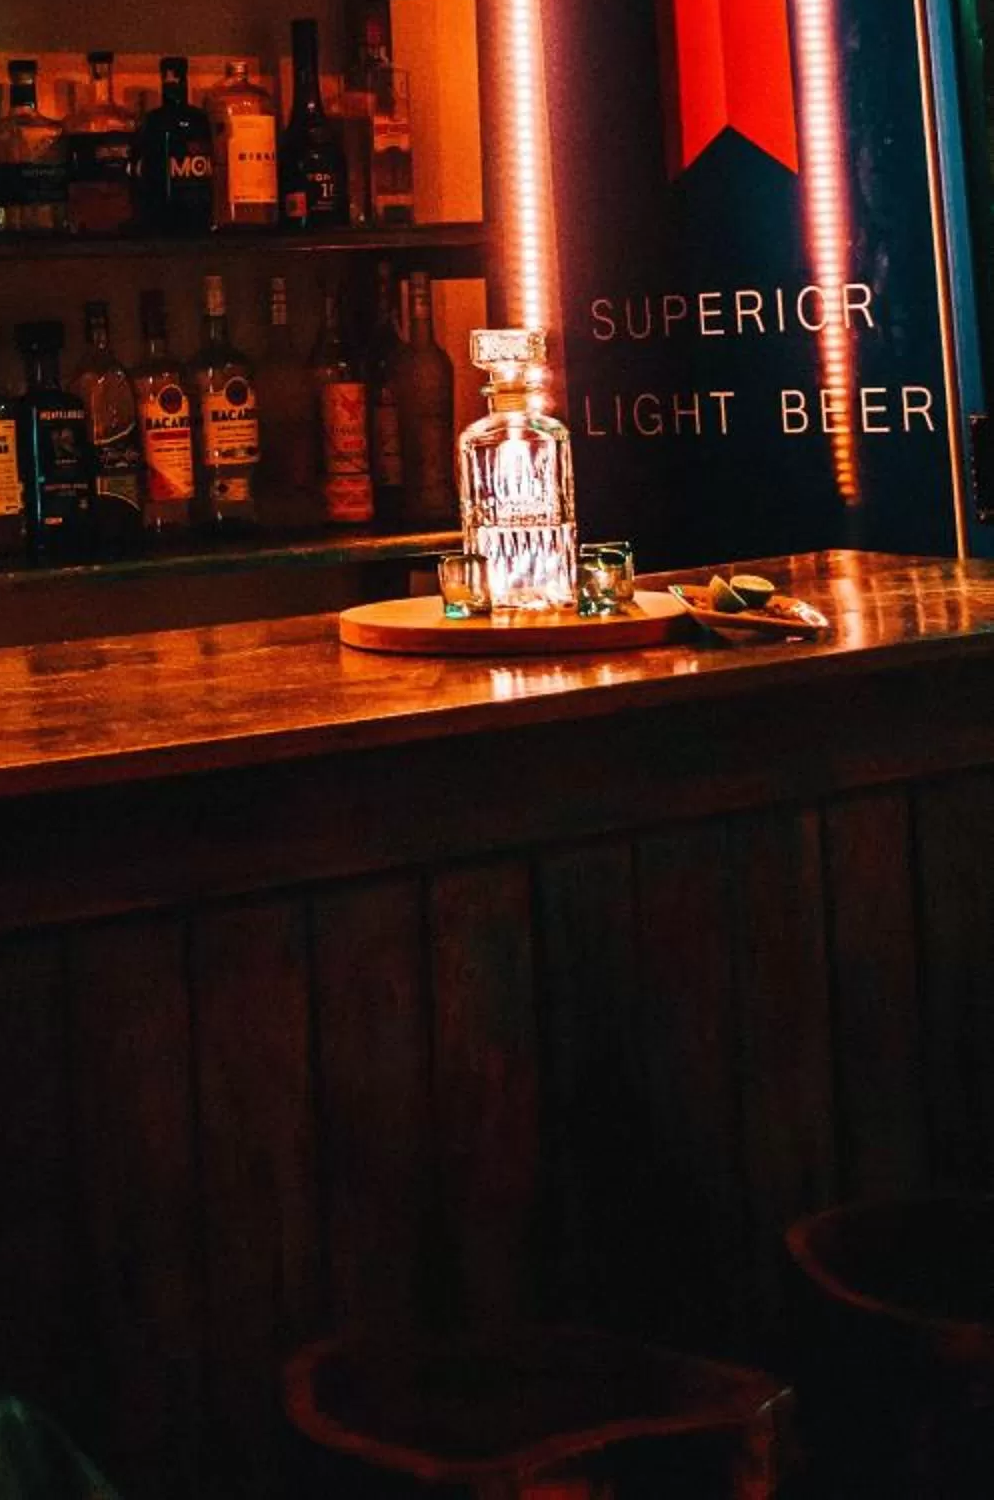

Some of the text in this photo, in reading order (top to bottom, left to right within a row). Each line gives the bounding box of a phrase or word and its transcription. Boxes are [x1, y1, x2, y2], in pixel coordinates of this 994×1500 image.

[591, 282, 875, 341] SUPERIOR
[584, 385, 936, 436] LIGHT BEER
